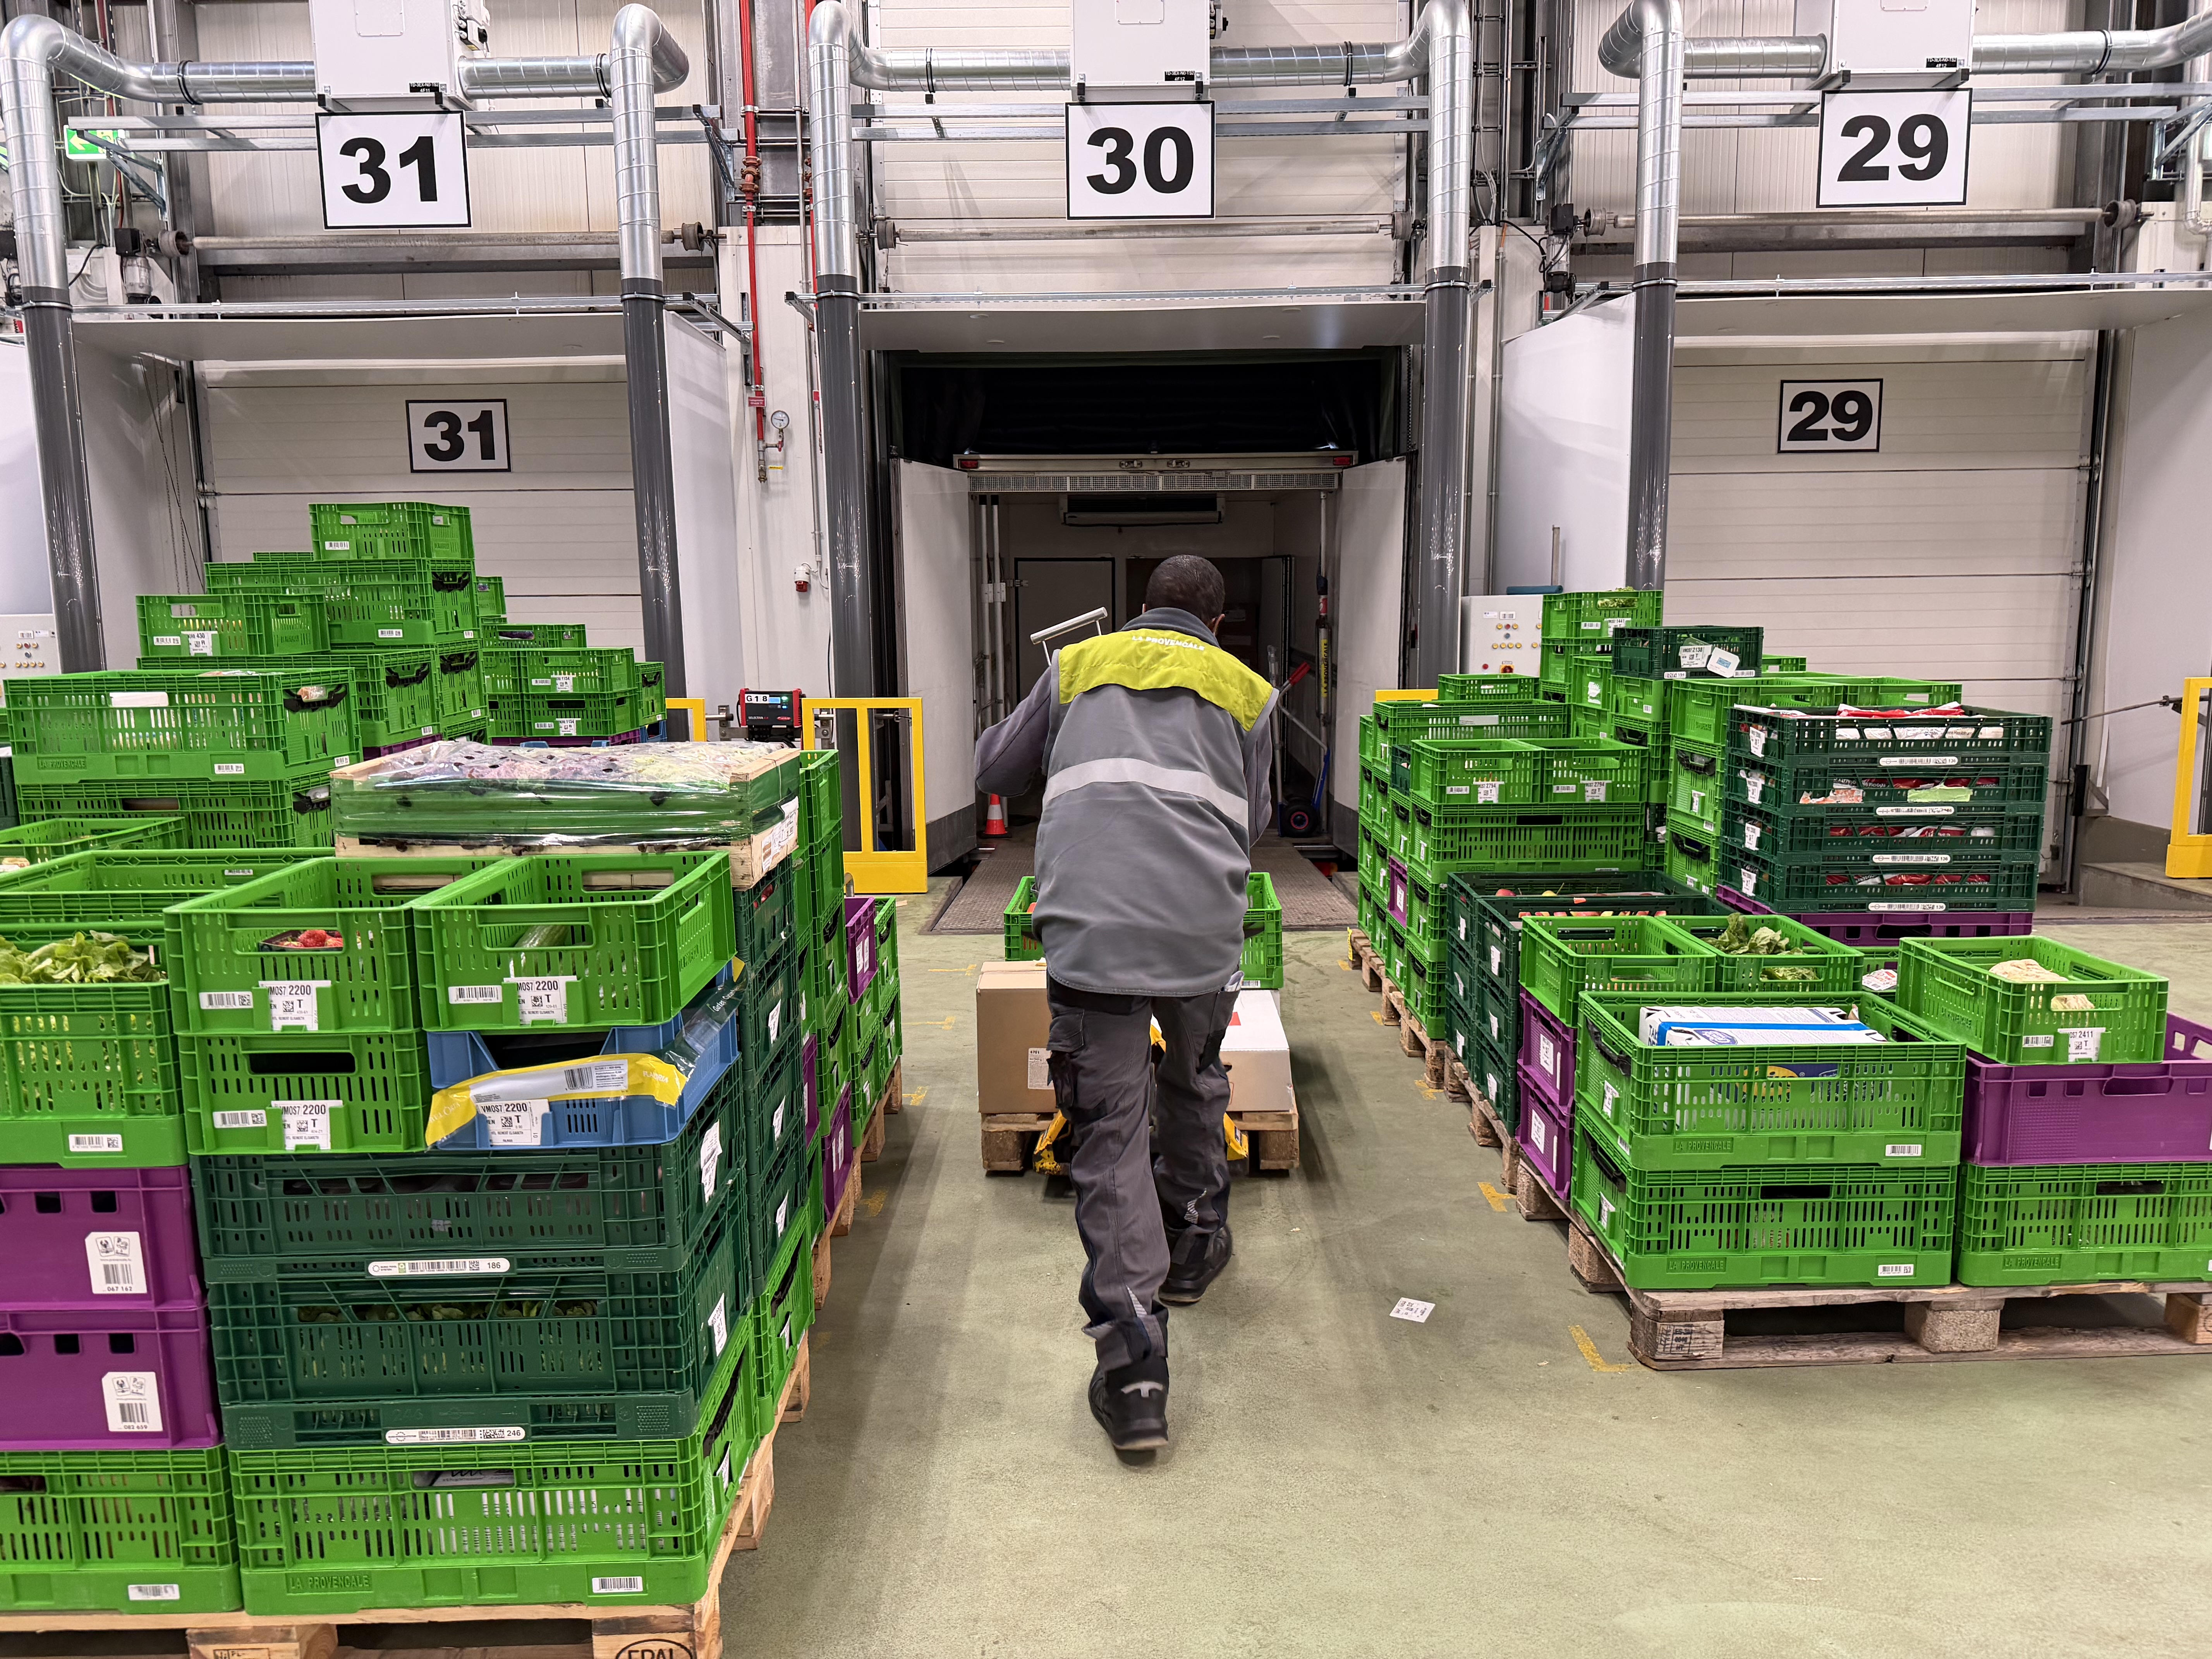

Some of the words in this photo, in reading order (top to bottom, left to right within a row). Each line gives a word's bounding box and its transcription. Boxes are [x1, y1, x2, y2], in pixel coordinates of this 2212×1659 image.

[1838, 114, 1948, 181] 29
[1087, 127, 1193, 194] 30
[340, 136, 437, 203] 31
[1787, 390, 1872, 441] 29
[424, 410, 495, 461] 31
[289, 985, 311, 996] 2200
[535, 981, 558, 991] 2200
[544, 994, 551, 1003] T
[297, 999, 304, 1008] T
[2078, 1030, 2093, 1039] 2411
[303, 1104, 326, 1115] 2200
[481, 1104, 502, 1113] VMOS7
[504, 1103, 528, 1113] 2200
[311, 1119, 318, 1128] T
[514, 1115, 522, 1124] T
[1676, 1142, 1683, 1150] LA
[1669, 1261, 1677, 1269] LA
[2005, 1259, 2012, 1267] LA
[291, 1580, 302, 1589] LA
